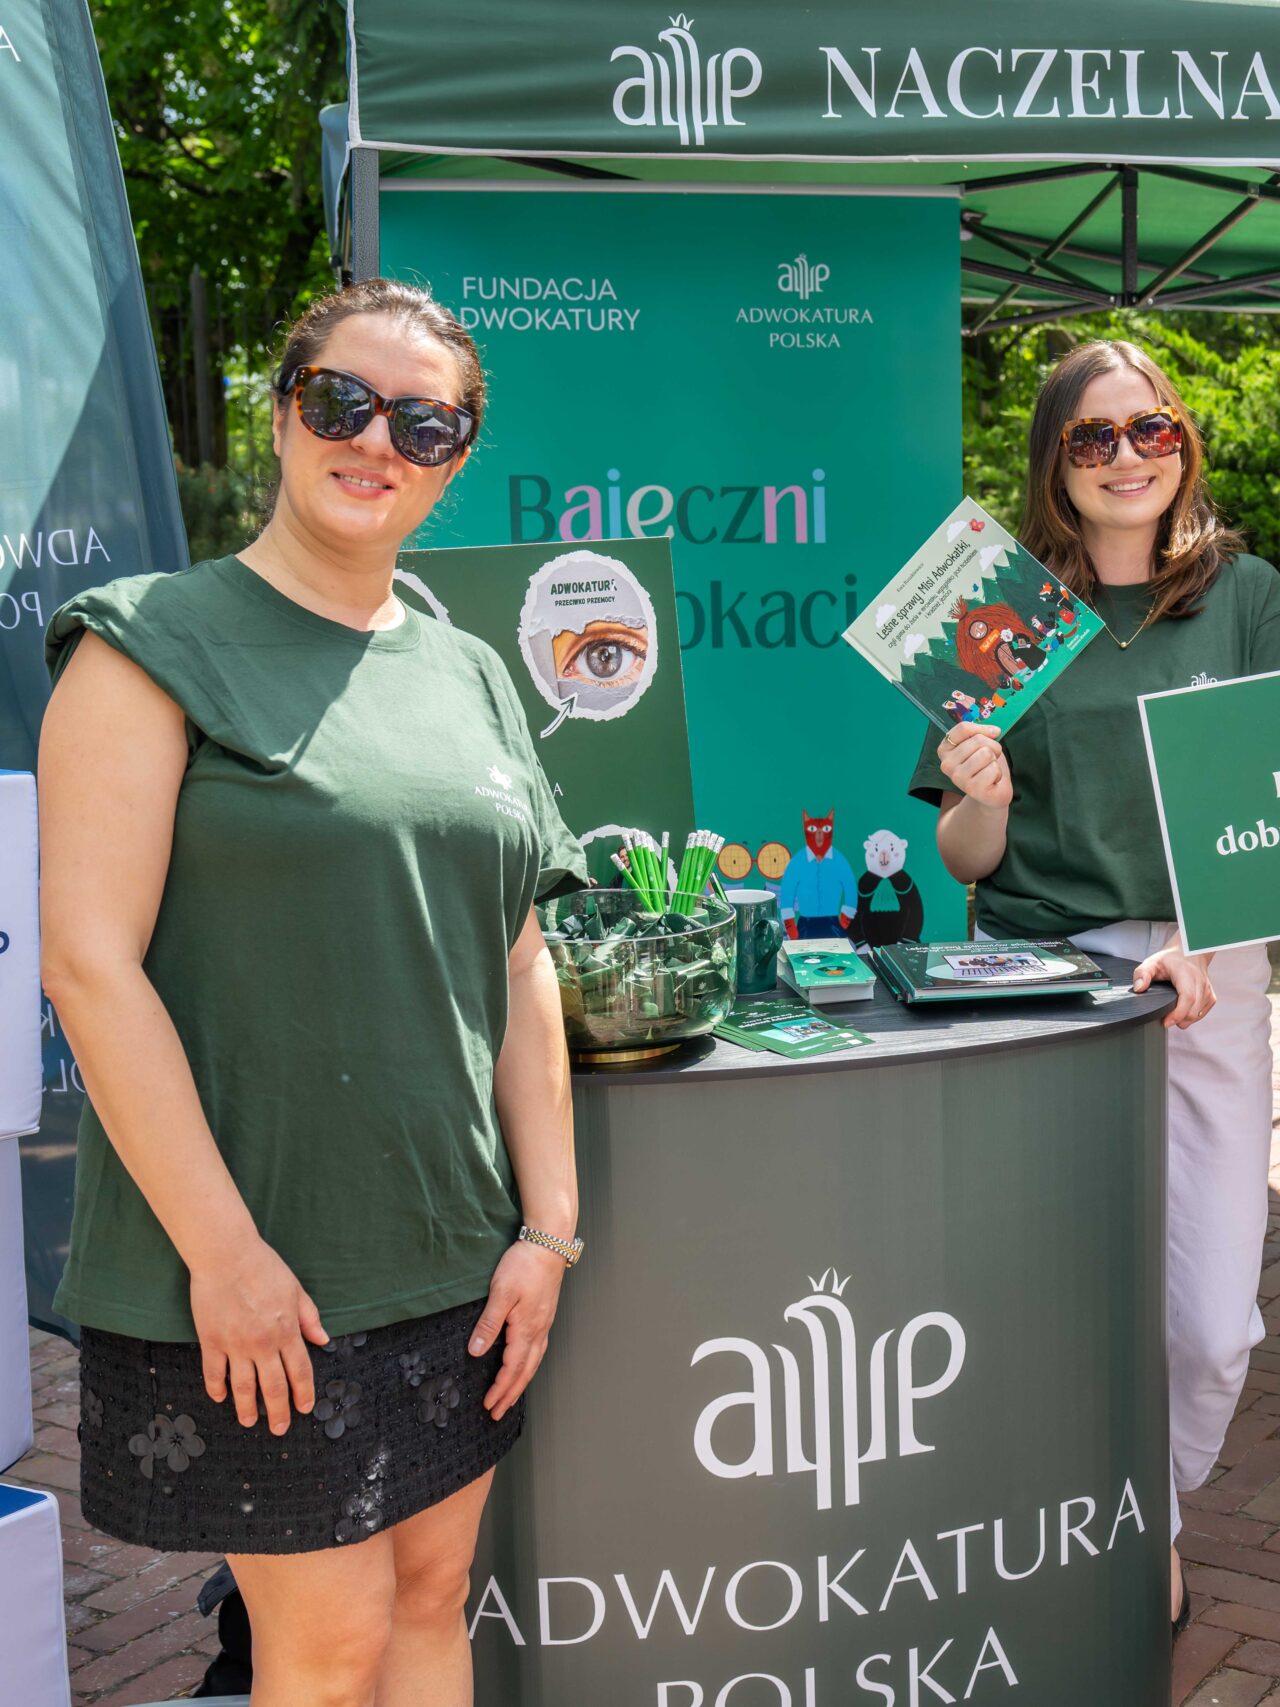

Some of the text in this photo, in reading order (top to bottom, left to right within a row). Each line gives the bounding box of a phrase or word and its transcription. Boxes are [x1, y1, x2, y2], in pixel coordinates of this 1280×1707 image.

[463, 276, 618, 301] FUNDACJA
[460, 307, 641, 331] DWOKATURY
[735, 307, 874, 324] ADWOKATURA
[769, 332, 841, 349] POLSKA
[876, 538, 971, 640] Leśne sprawy Misi Adwokatki,
[554, 596, 615, 607] PRZECIWKO PRZEMOCY
[495, 802, 527, 823] POLSKA
[468, 1476, 1147, 1647] ADWOKATURA
